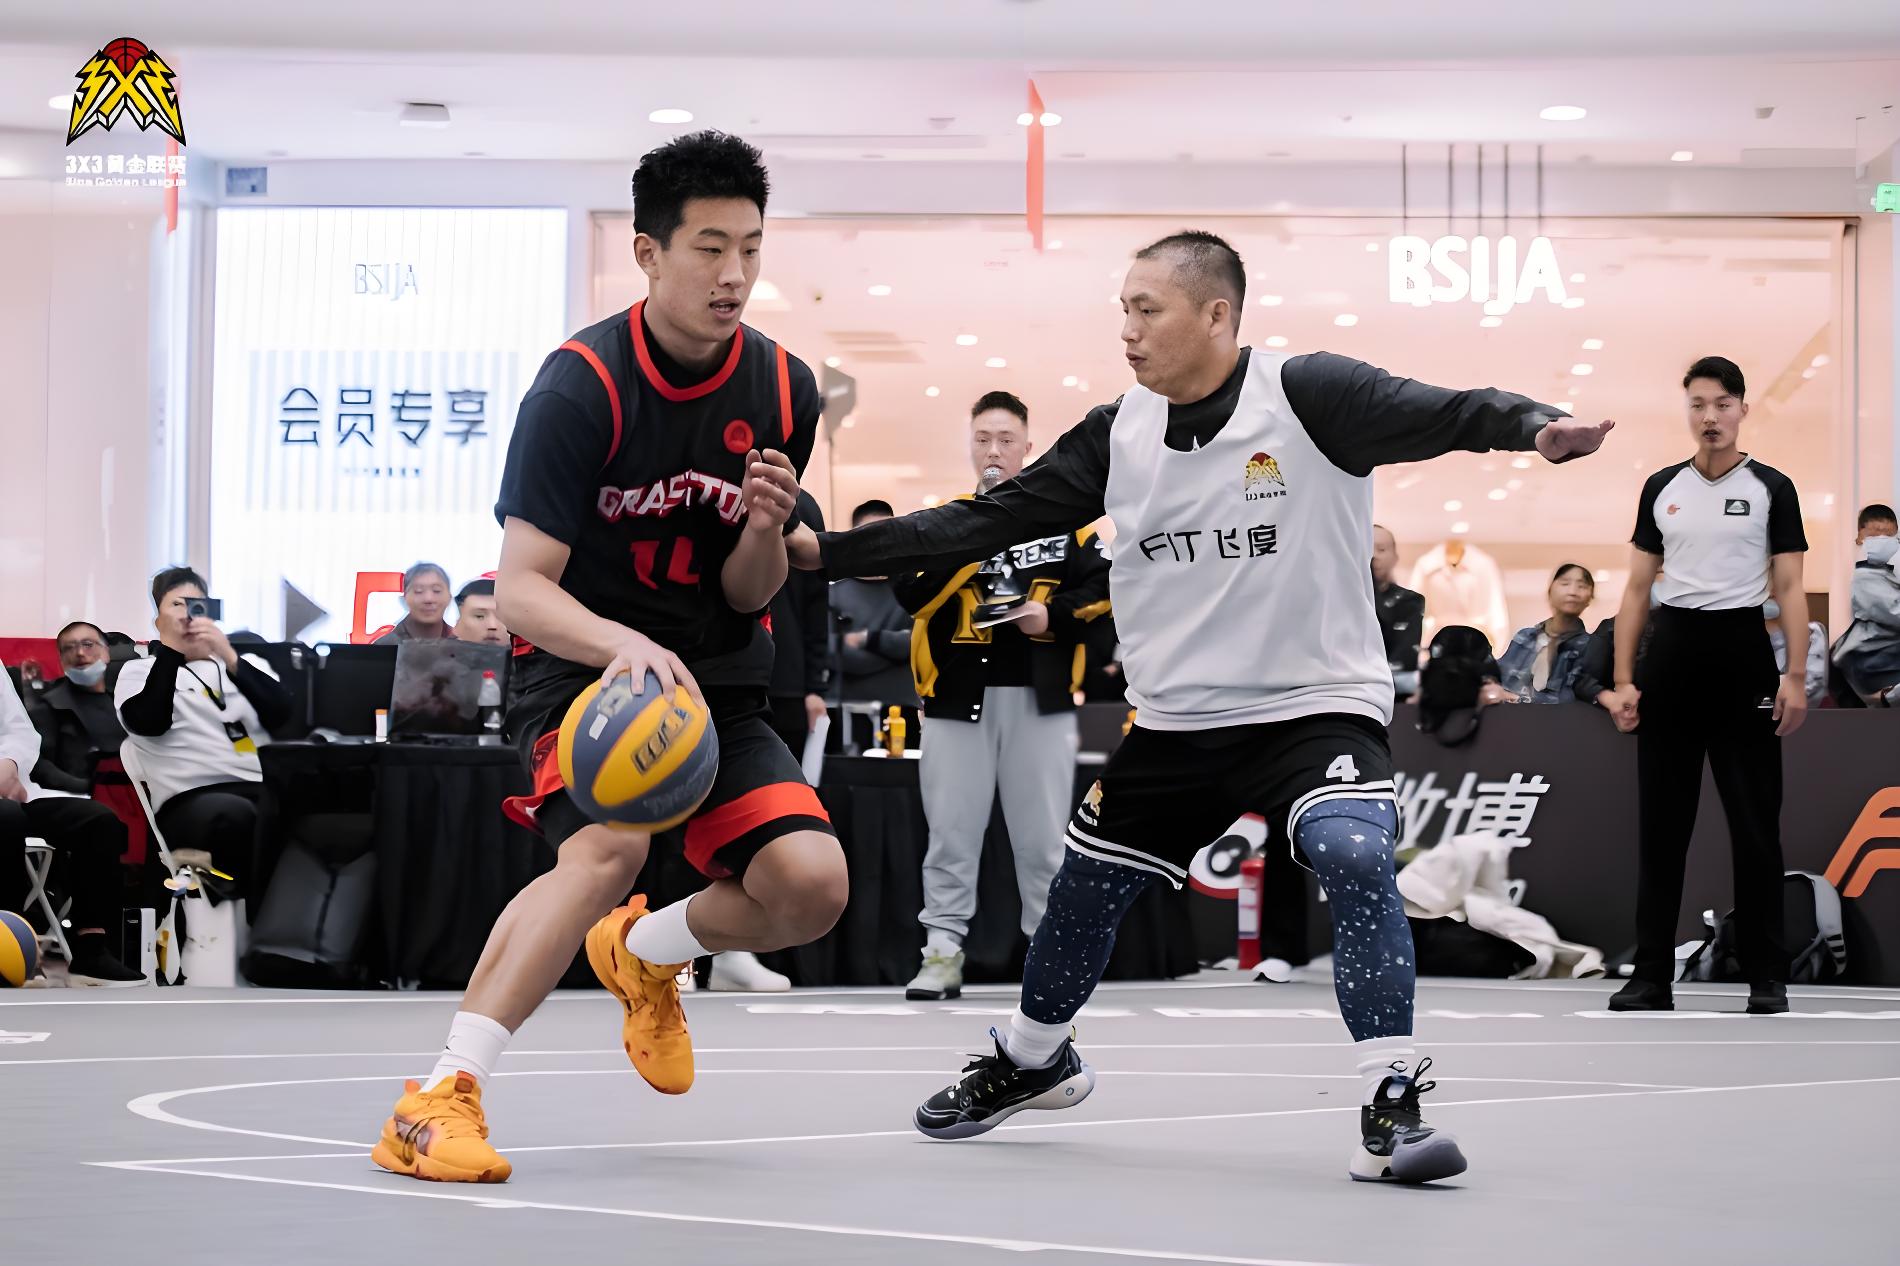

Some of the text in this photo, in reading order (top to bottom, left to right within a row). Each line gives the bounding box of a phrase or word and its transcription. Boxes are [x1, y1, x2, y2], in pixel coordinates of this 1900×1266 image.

[1389, 235, 1567, 316] BSIJA
[279, 387, 488, 448] 会员专享
[1139, 524, 1278, 562] FIT 飞度
[1325, 754, 1360, 782] 4
